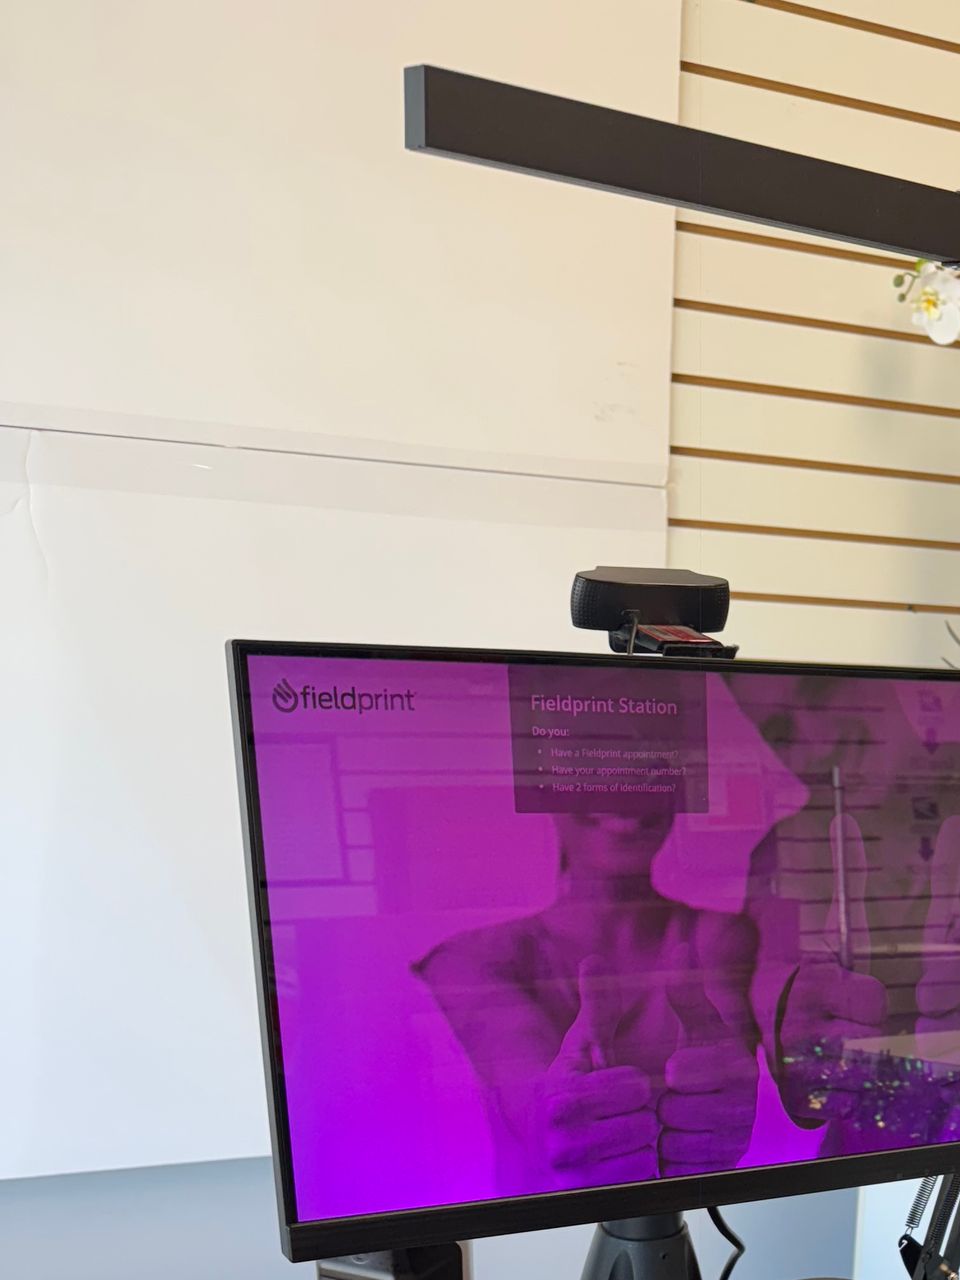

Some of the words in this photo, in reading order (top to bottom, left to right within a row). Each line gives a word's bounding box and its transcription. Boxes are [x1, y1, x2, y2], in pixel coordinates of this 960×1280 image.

[300, 685, 415, 714] fieldprint
[531, 694, 615, 717] Fieldprint
[618, 698, 678, 715] Station
[532, 726, 546, 736] Do
[547, 727, 570, 739] you:
[551, 748, 573, 758] Have
[582, 748, 621, 760] Fieldprint
[552, 766, 574, 776] Have
[596, 767, 650, 778] appointment
[552, 784, 574, 793] Have
[583, 784, 608, 793] forms
[609, 784, 619, 793] of
[620, 784, 676, 793] identification?
